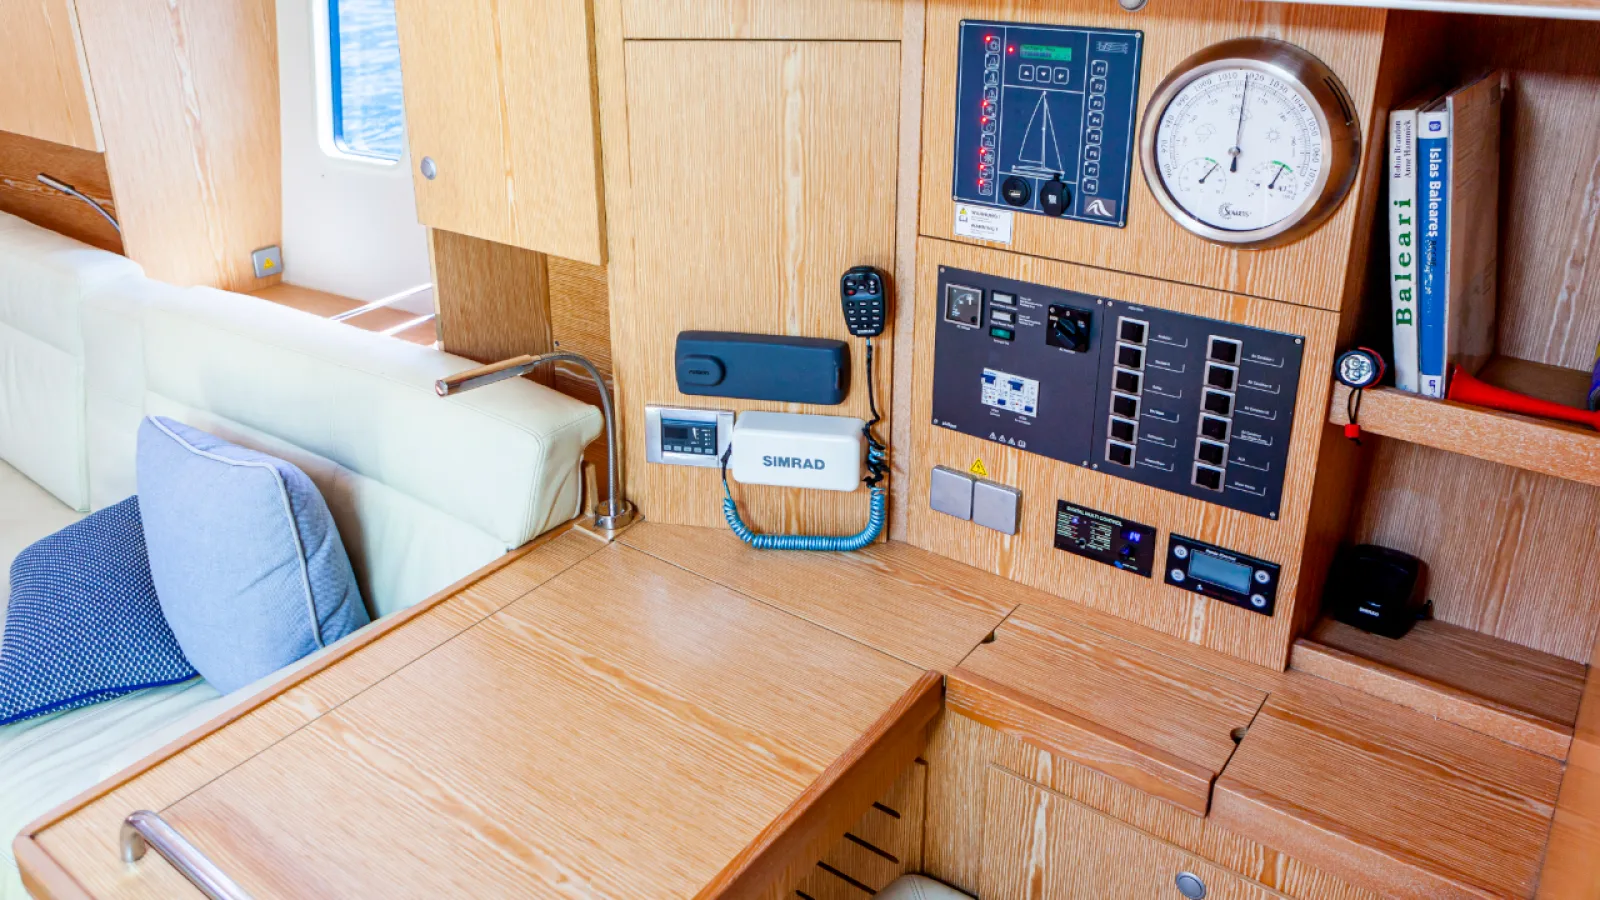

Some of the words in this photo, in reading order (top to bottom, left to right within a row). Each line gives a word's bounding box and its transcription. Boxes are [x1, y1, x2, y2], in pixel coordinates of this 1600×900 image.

[1218, 72, 1238, 81] 1010
[1269, 78, 1289, 94] 1030
[1292, 94, 1307, 113] 1040
[1393, 156, 1402, 179] Robin
[1404, 159, 1413, 178] Anne
[1429, 147, 1442, 178] Islas
[1428, 181, 1442, 237] Baleares
[1393, 198, 1413, 326] Baleari
[762, 455, 826, 471] SIMRAD
